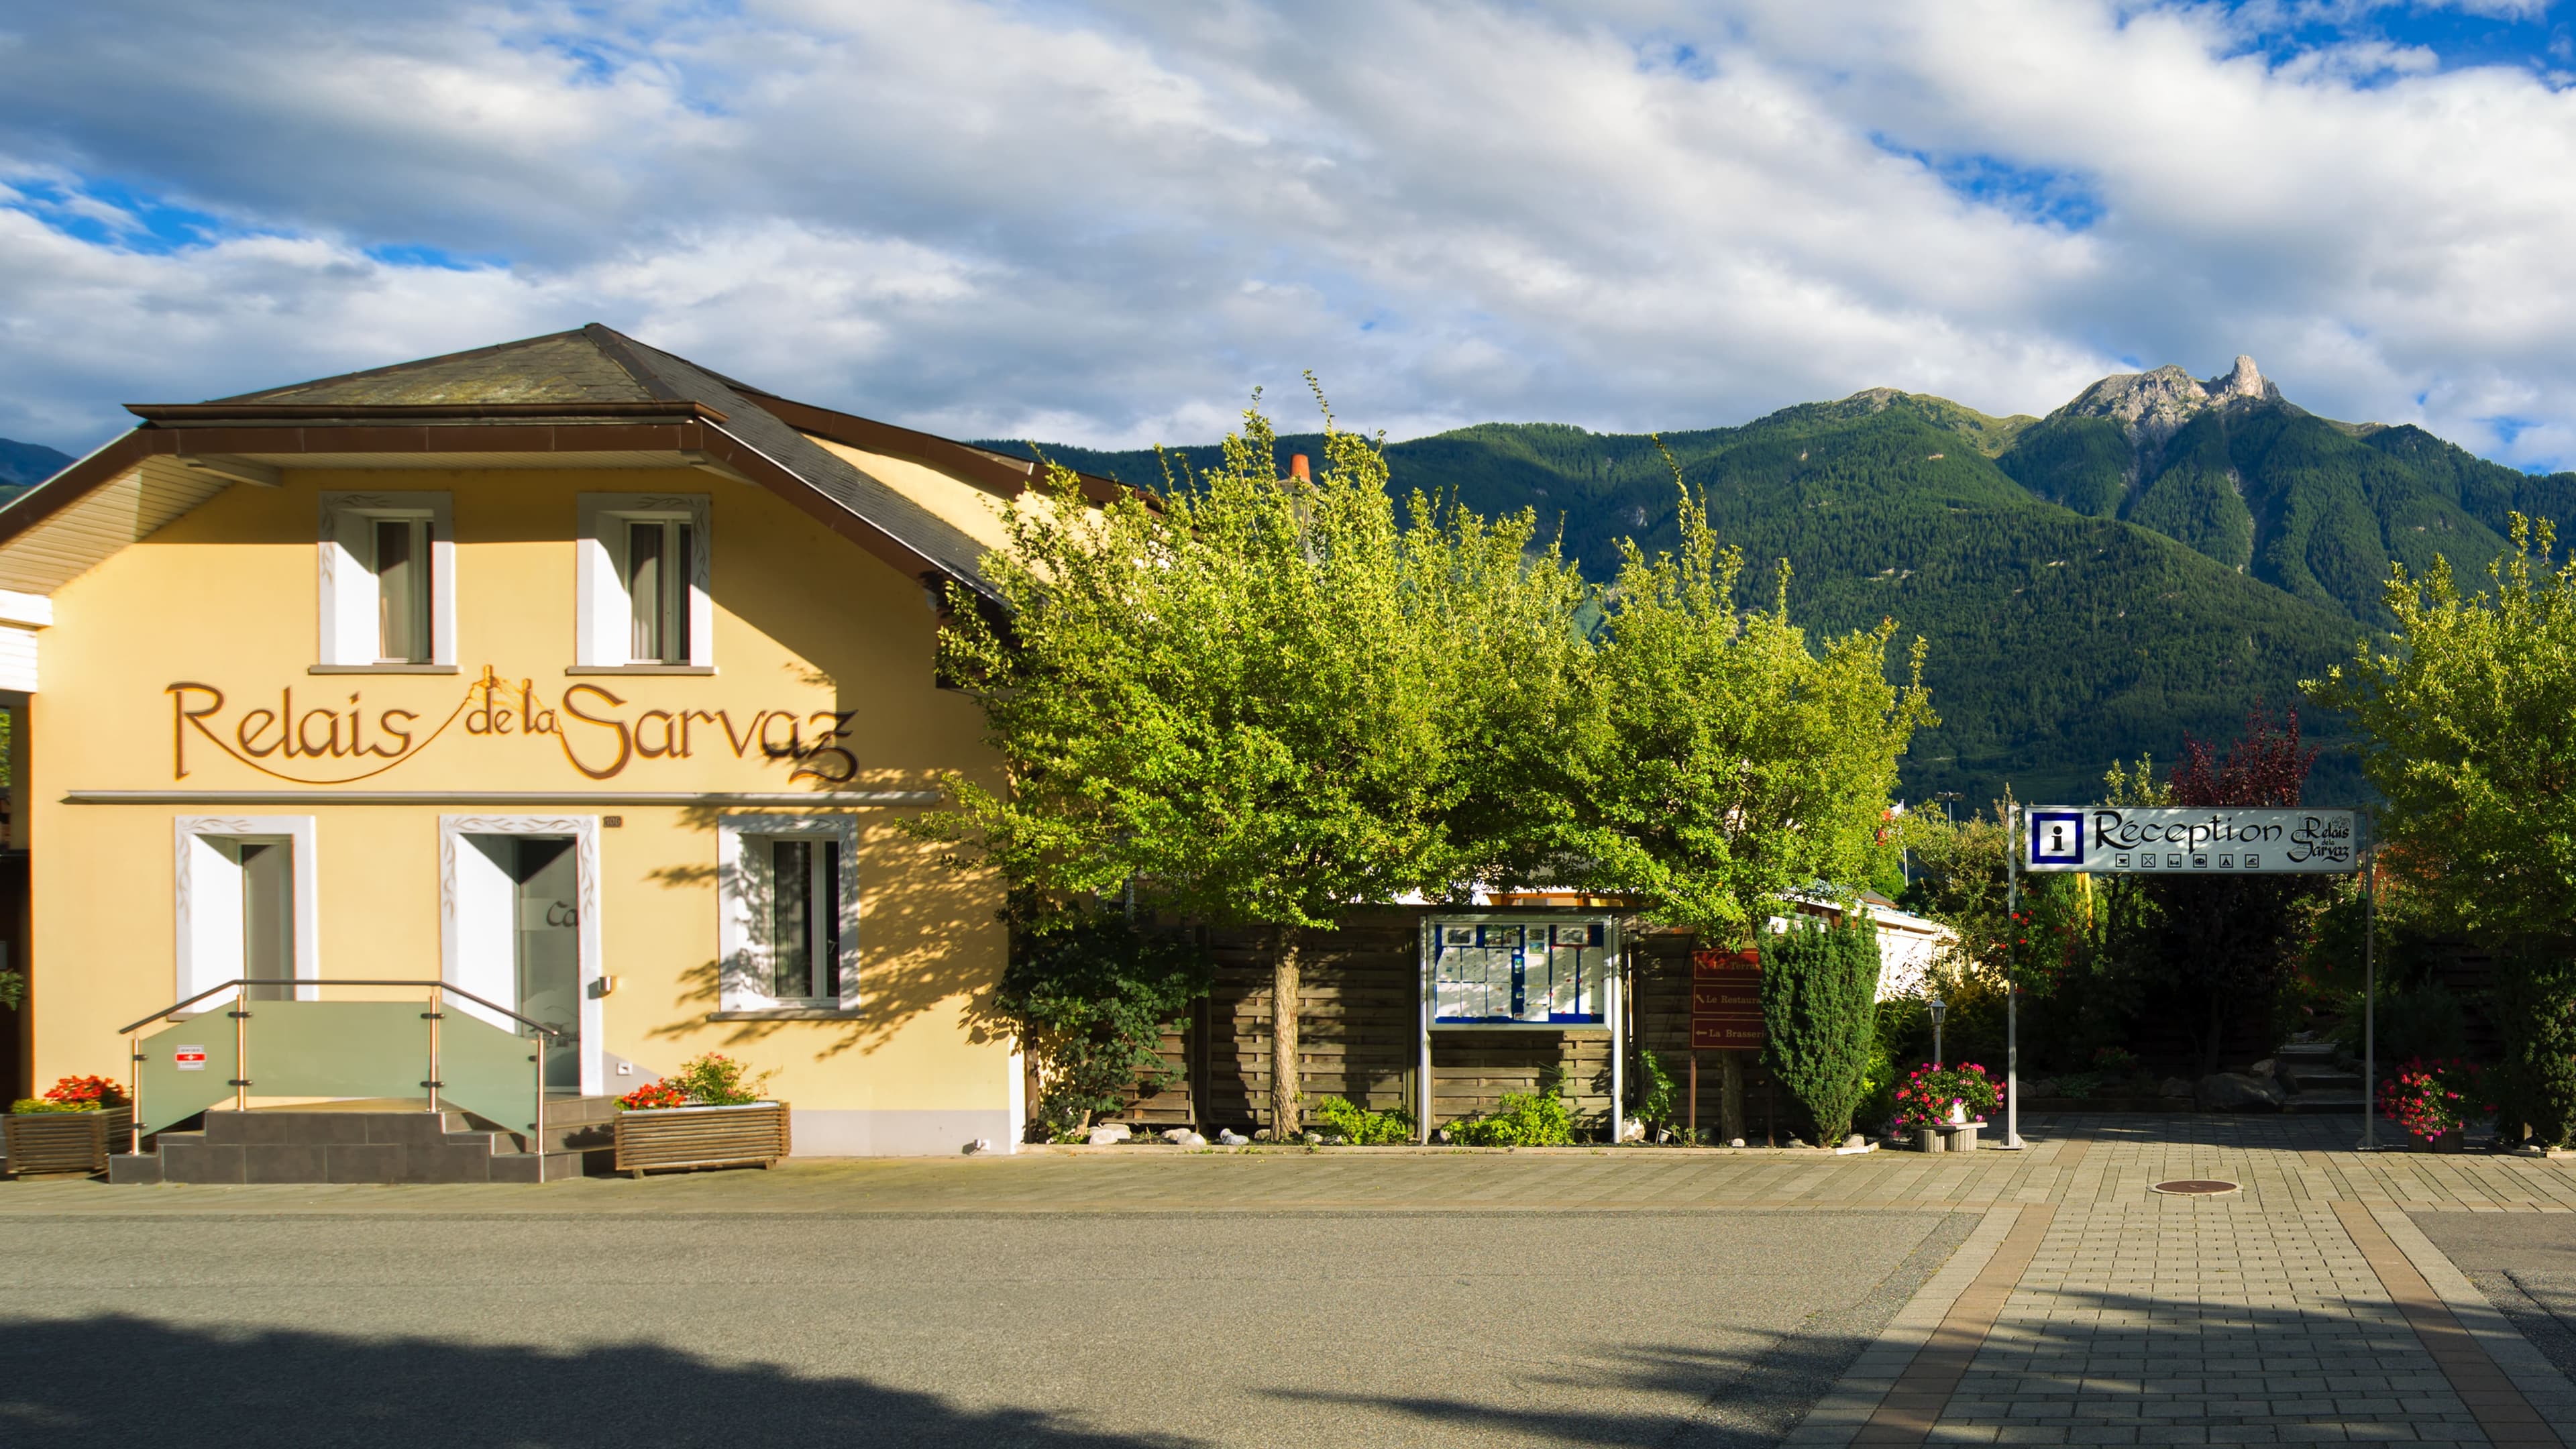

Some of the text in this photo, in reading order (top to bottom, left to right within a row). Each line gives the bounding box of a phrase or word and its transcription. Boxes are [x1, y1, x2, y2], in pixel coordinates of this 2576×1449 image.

[166, 682, 859, 784] Relais de la Sarvaz
[2092, 810, 2283, 855] Réception
[2304, 816, 2350, 839] Relais
[2286, 829, 2351, 863] Sarvaz
[1706, 995, 1717, 1004] Le
[1709, 1029, 1721, 1038] La
